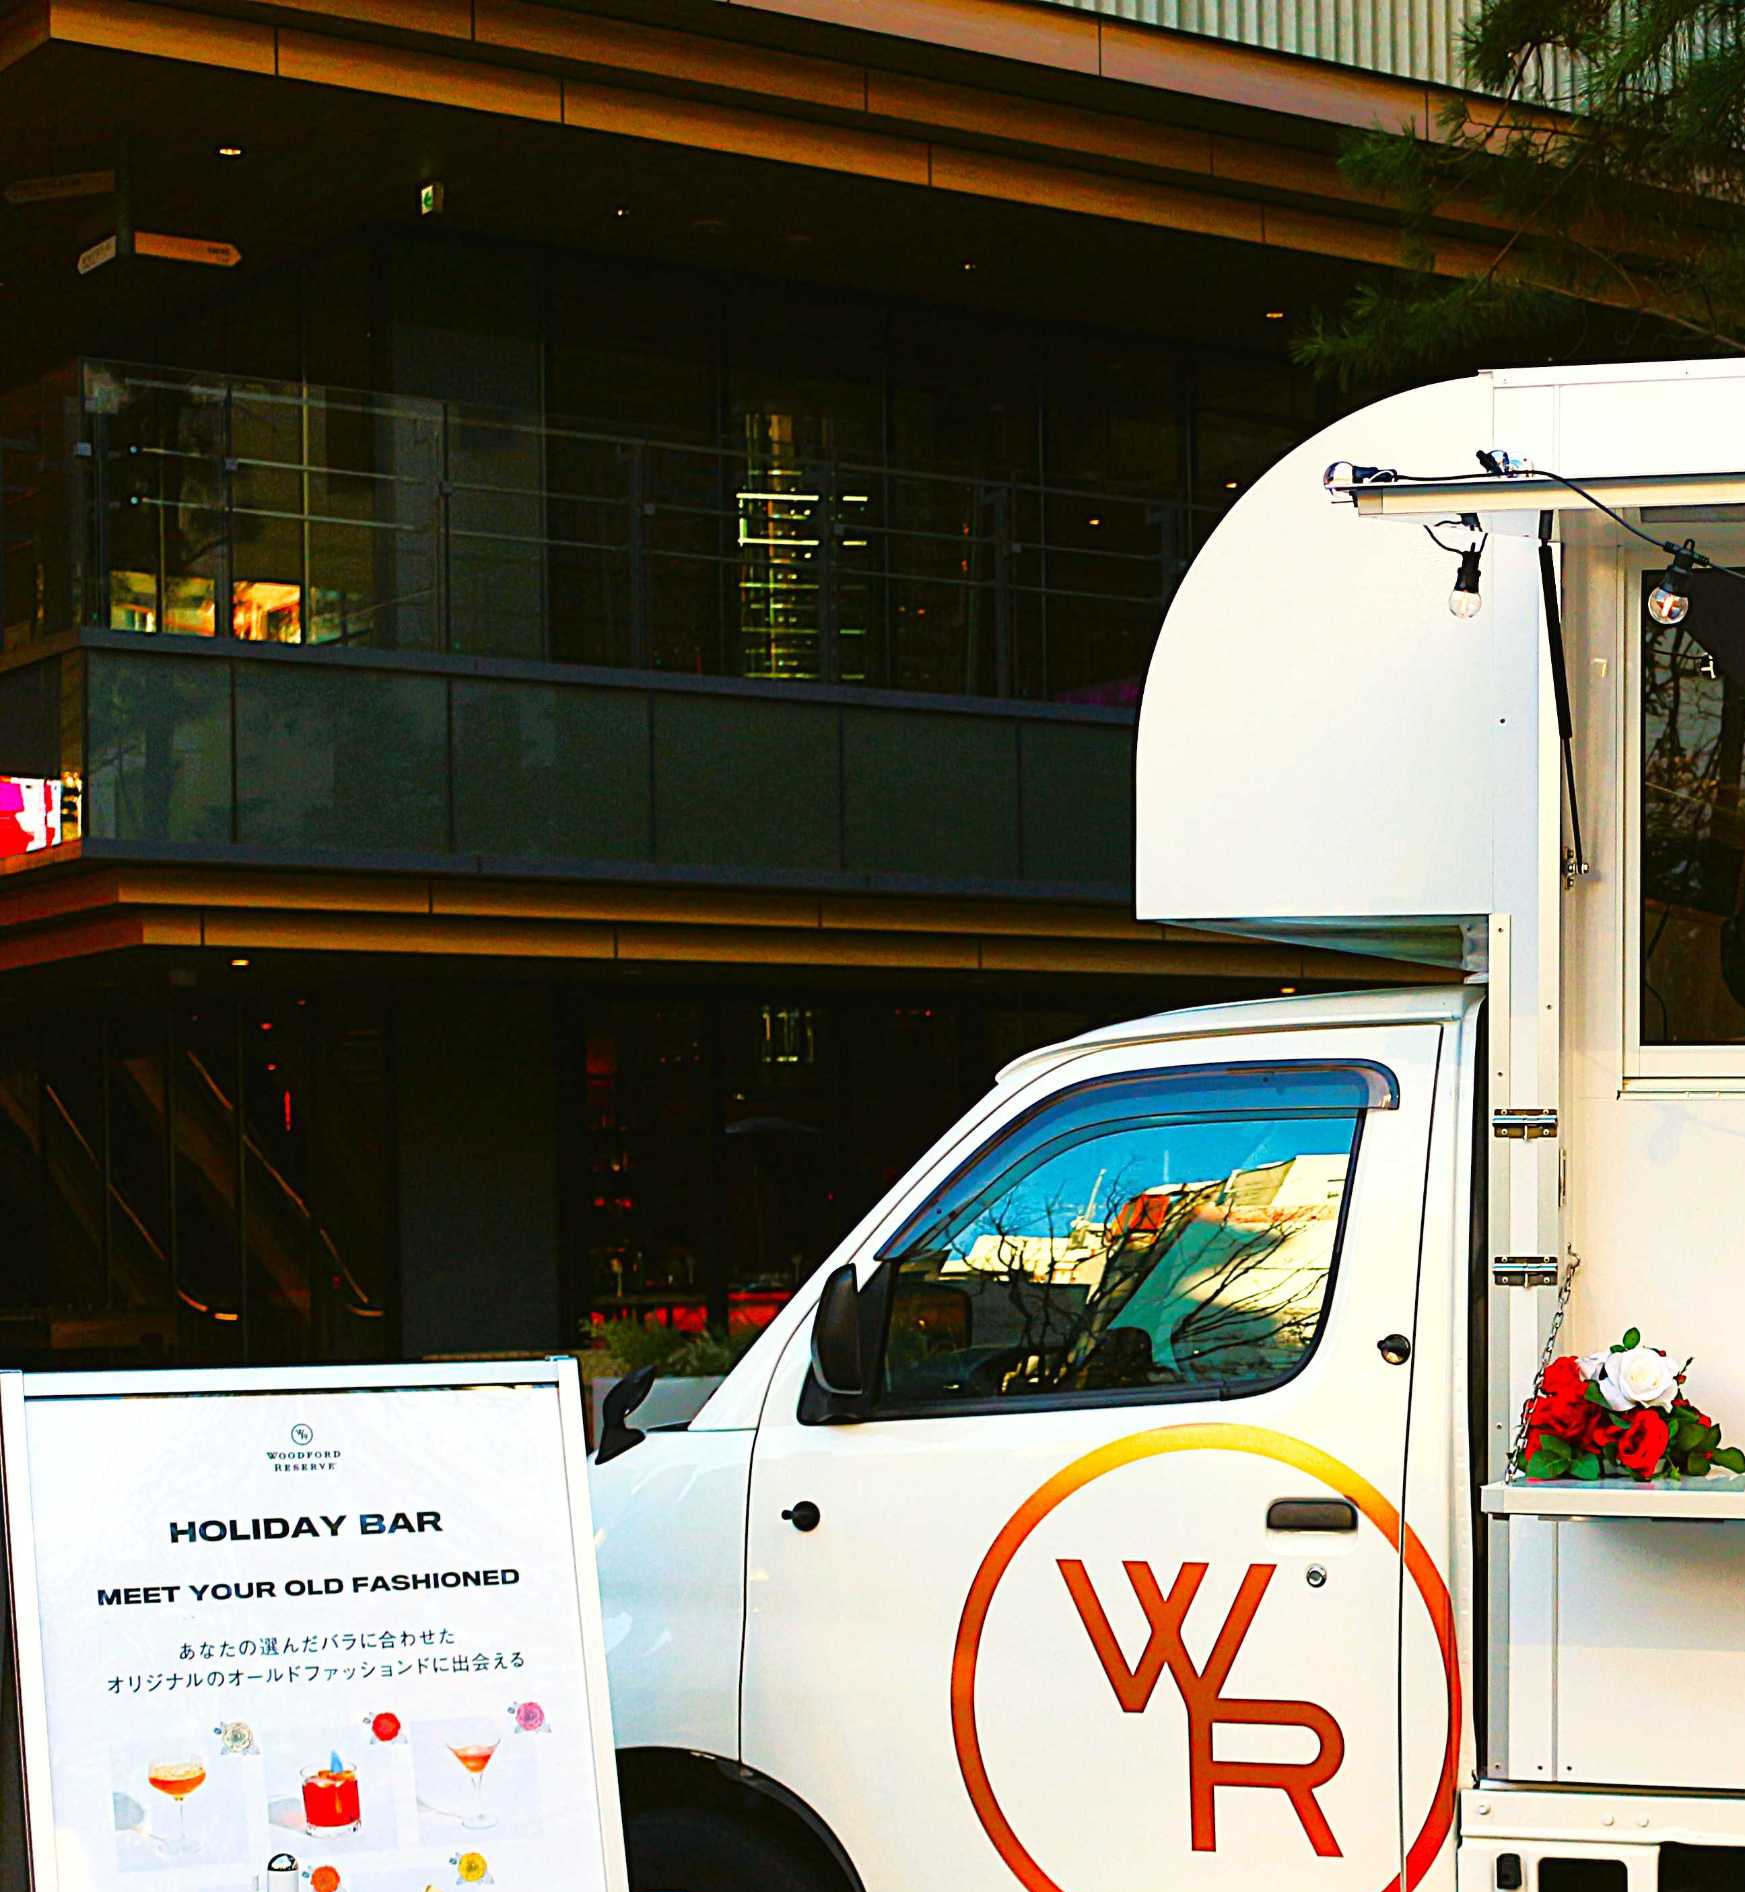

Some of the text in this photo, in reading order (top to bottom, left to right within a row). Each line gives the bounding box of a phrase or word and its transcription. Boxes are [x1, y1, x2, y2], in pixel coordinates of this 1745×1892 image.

[266, 1450, 342, 1460] WOODFORD
[274, 1462, 337, 1473] RESERVE
[169, 1508, 444, 1545] HOLIDAY BAR
[97, 1567, 521, 1608] MEET YOUR OLD FASHIONED
[179, 1626, 456, 1661] あなたの選んだバラに合わせた
[106, 1650, 526, 1695] オリジナルのオールドファッションドに出会える
[1055, 1557, 1345, 1858] WR
